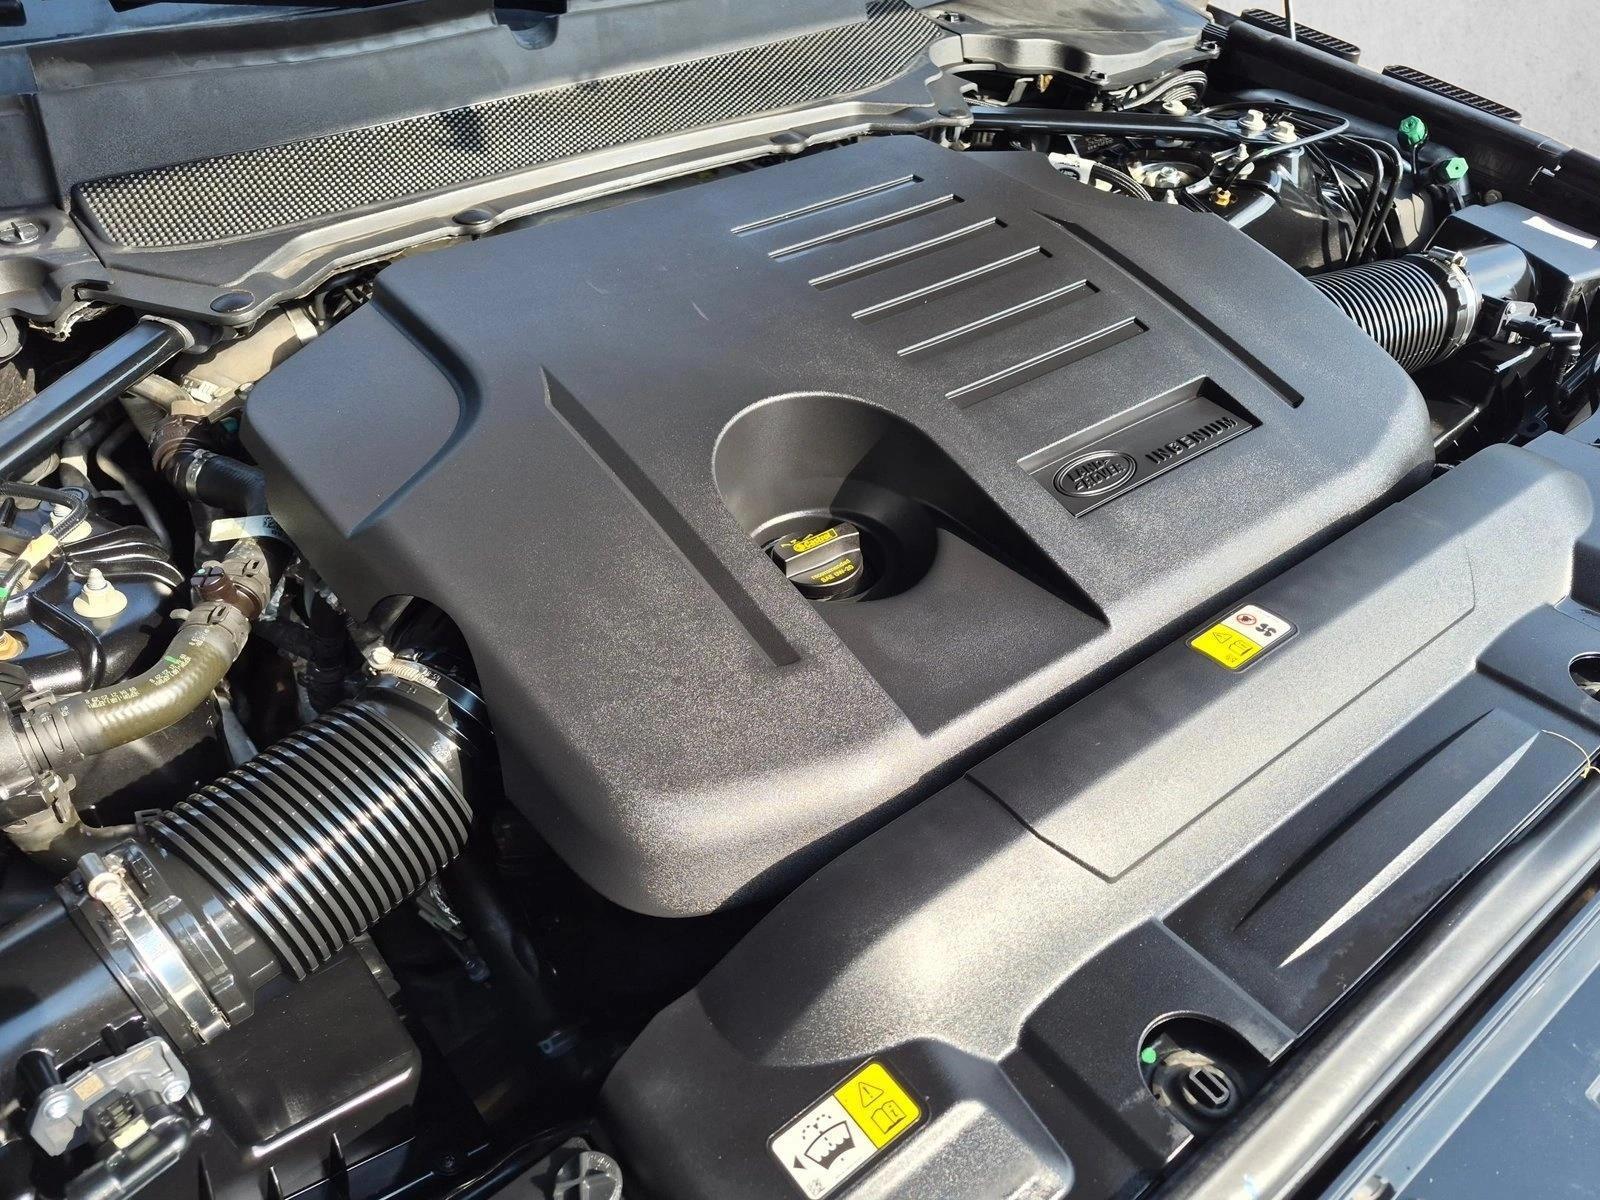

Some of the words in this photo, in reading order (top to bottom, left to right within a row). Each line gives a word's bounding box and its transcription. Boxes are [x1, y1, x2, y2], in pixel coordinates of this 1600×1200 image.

[1145, 416, 1238, 465] INGENIUM
[1067, 459, 1109, 482] LAND
[1081, 462, 1127, 491] ROVER
[804, 531, 833, 547] Castrol
